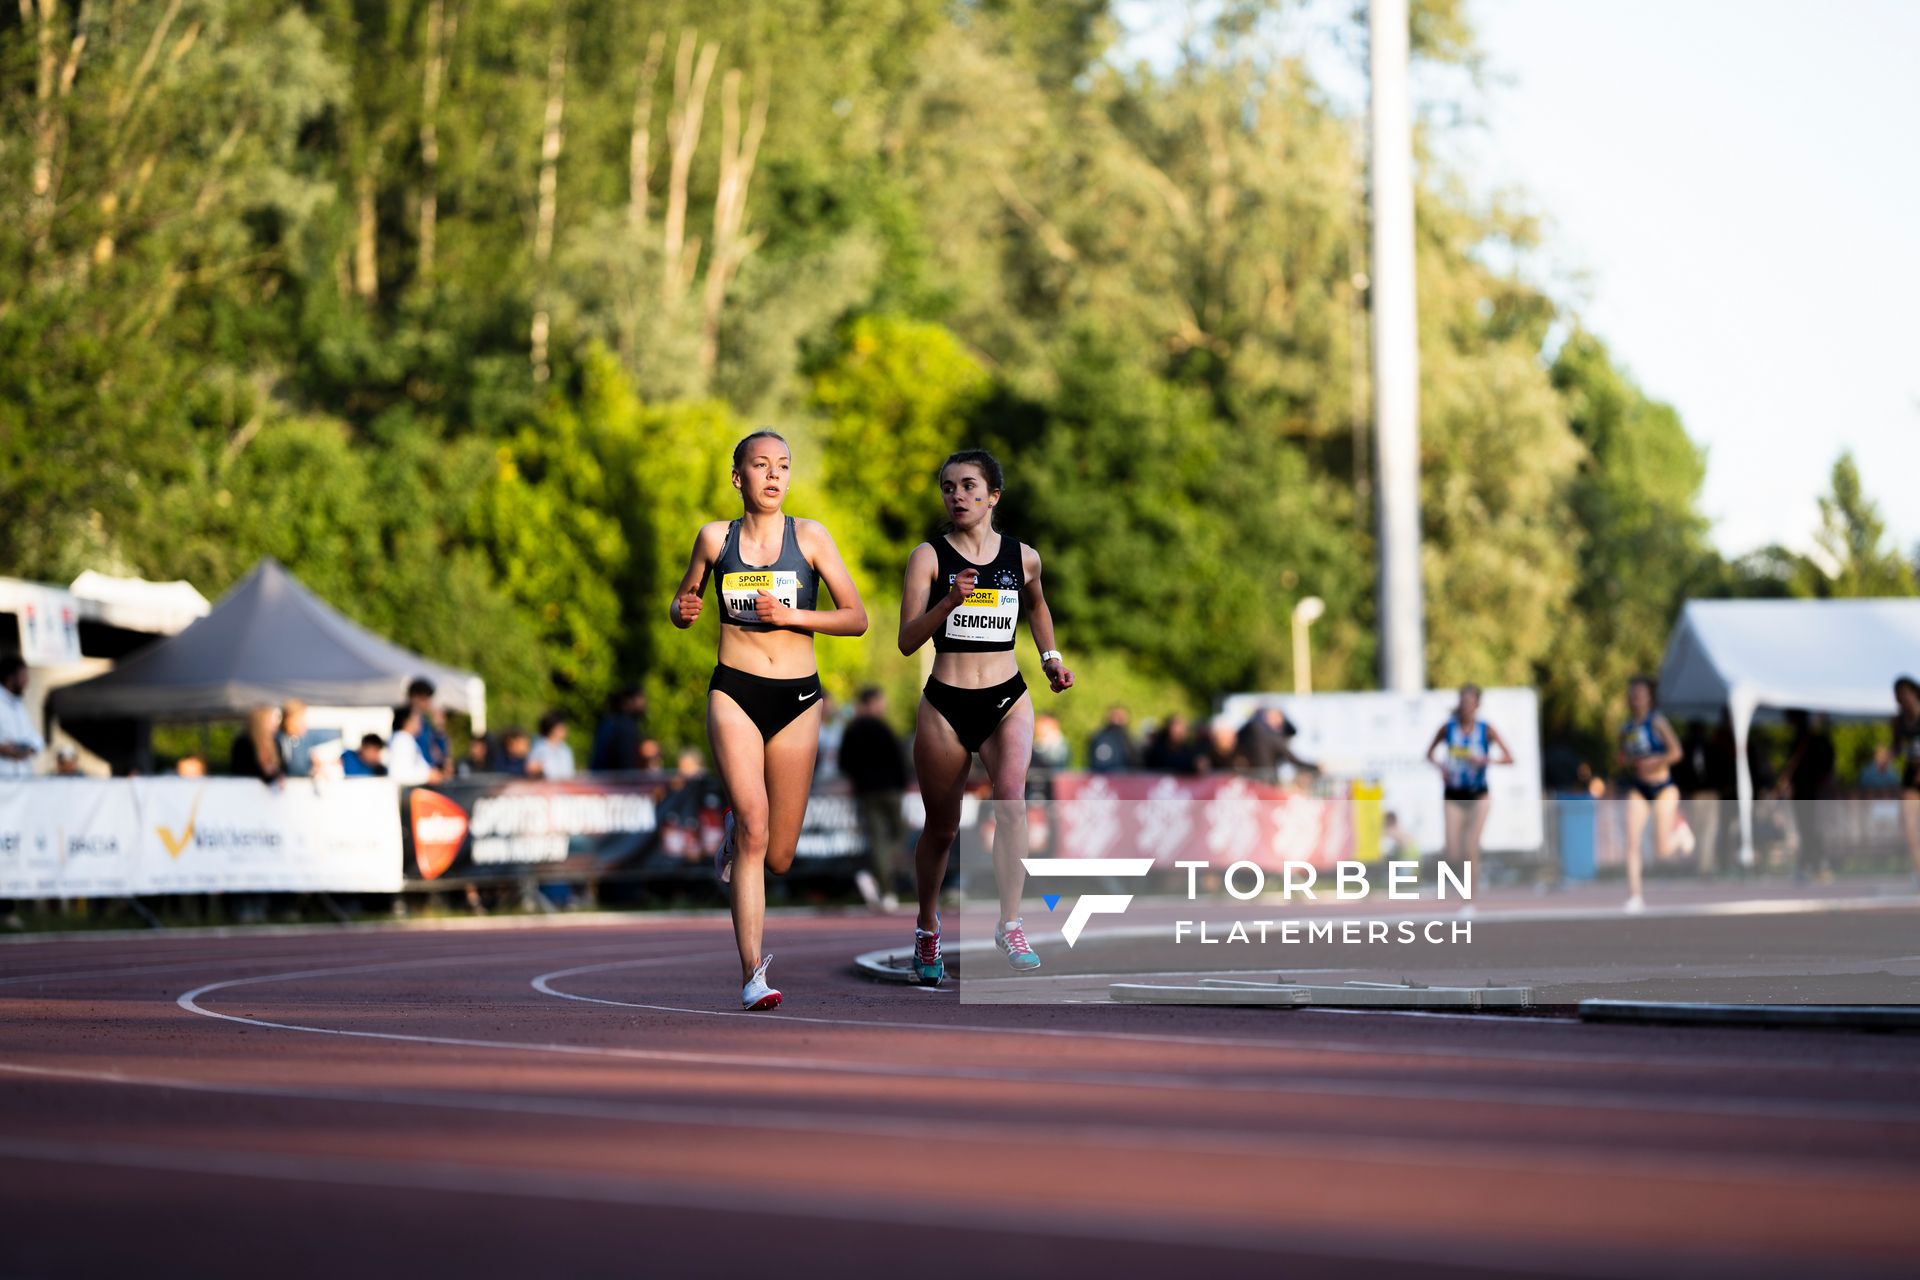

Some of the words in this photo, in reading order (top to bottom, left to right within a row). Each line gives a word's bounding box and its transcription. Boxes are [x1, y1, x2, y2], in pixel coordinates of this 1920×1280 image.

[730, 598, 791, 611] HINS
[1001, 595, 1017, 606] ifam
[953, 613, 1012, 630] SEMCHUK
